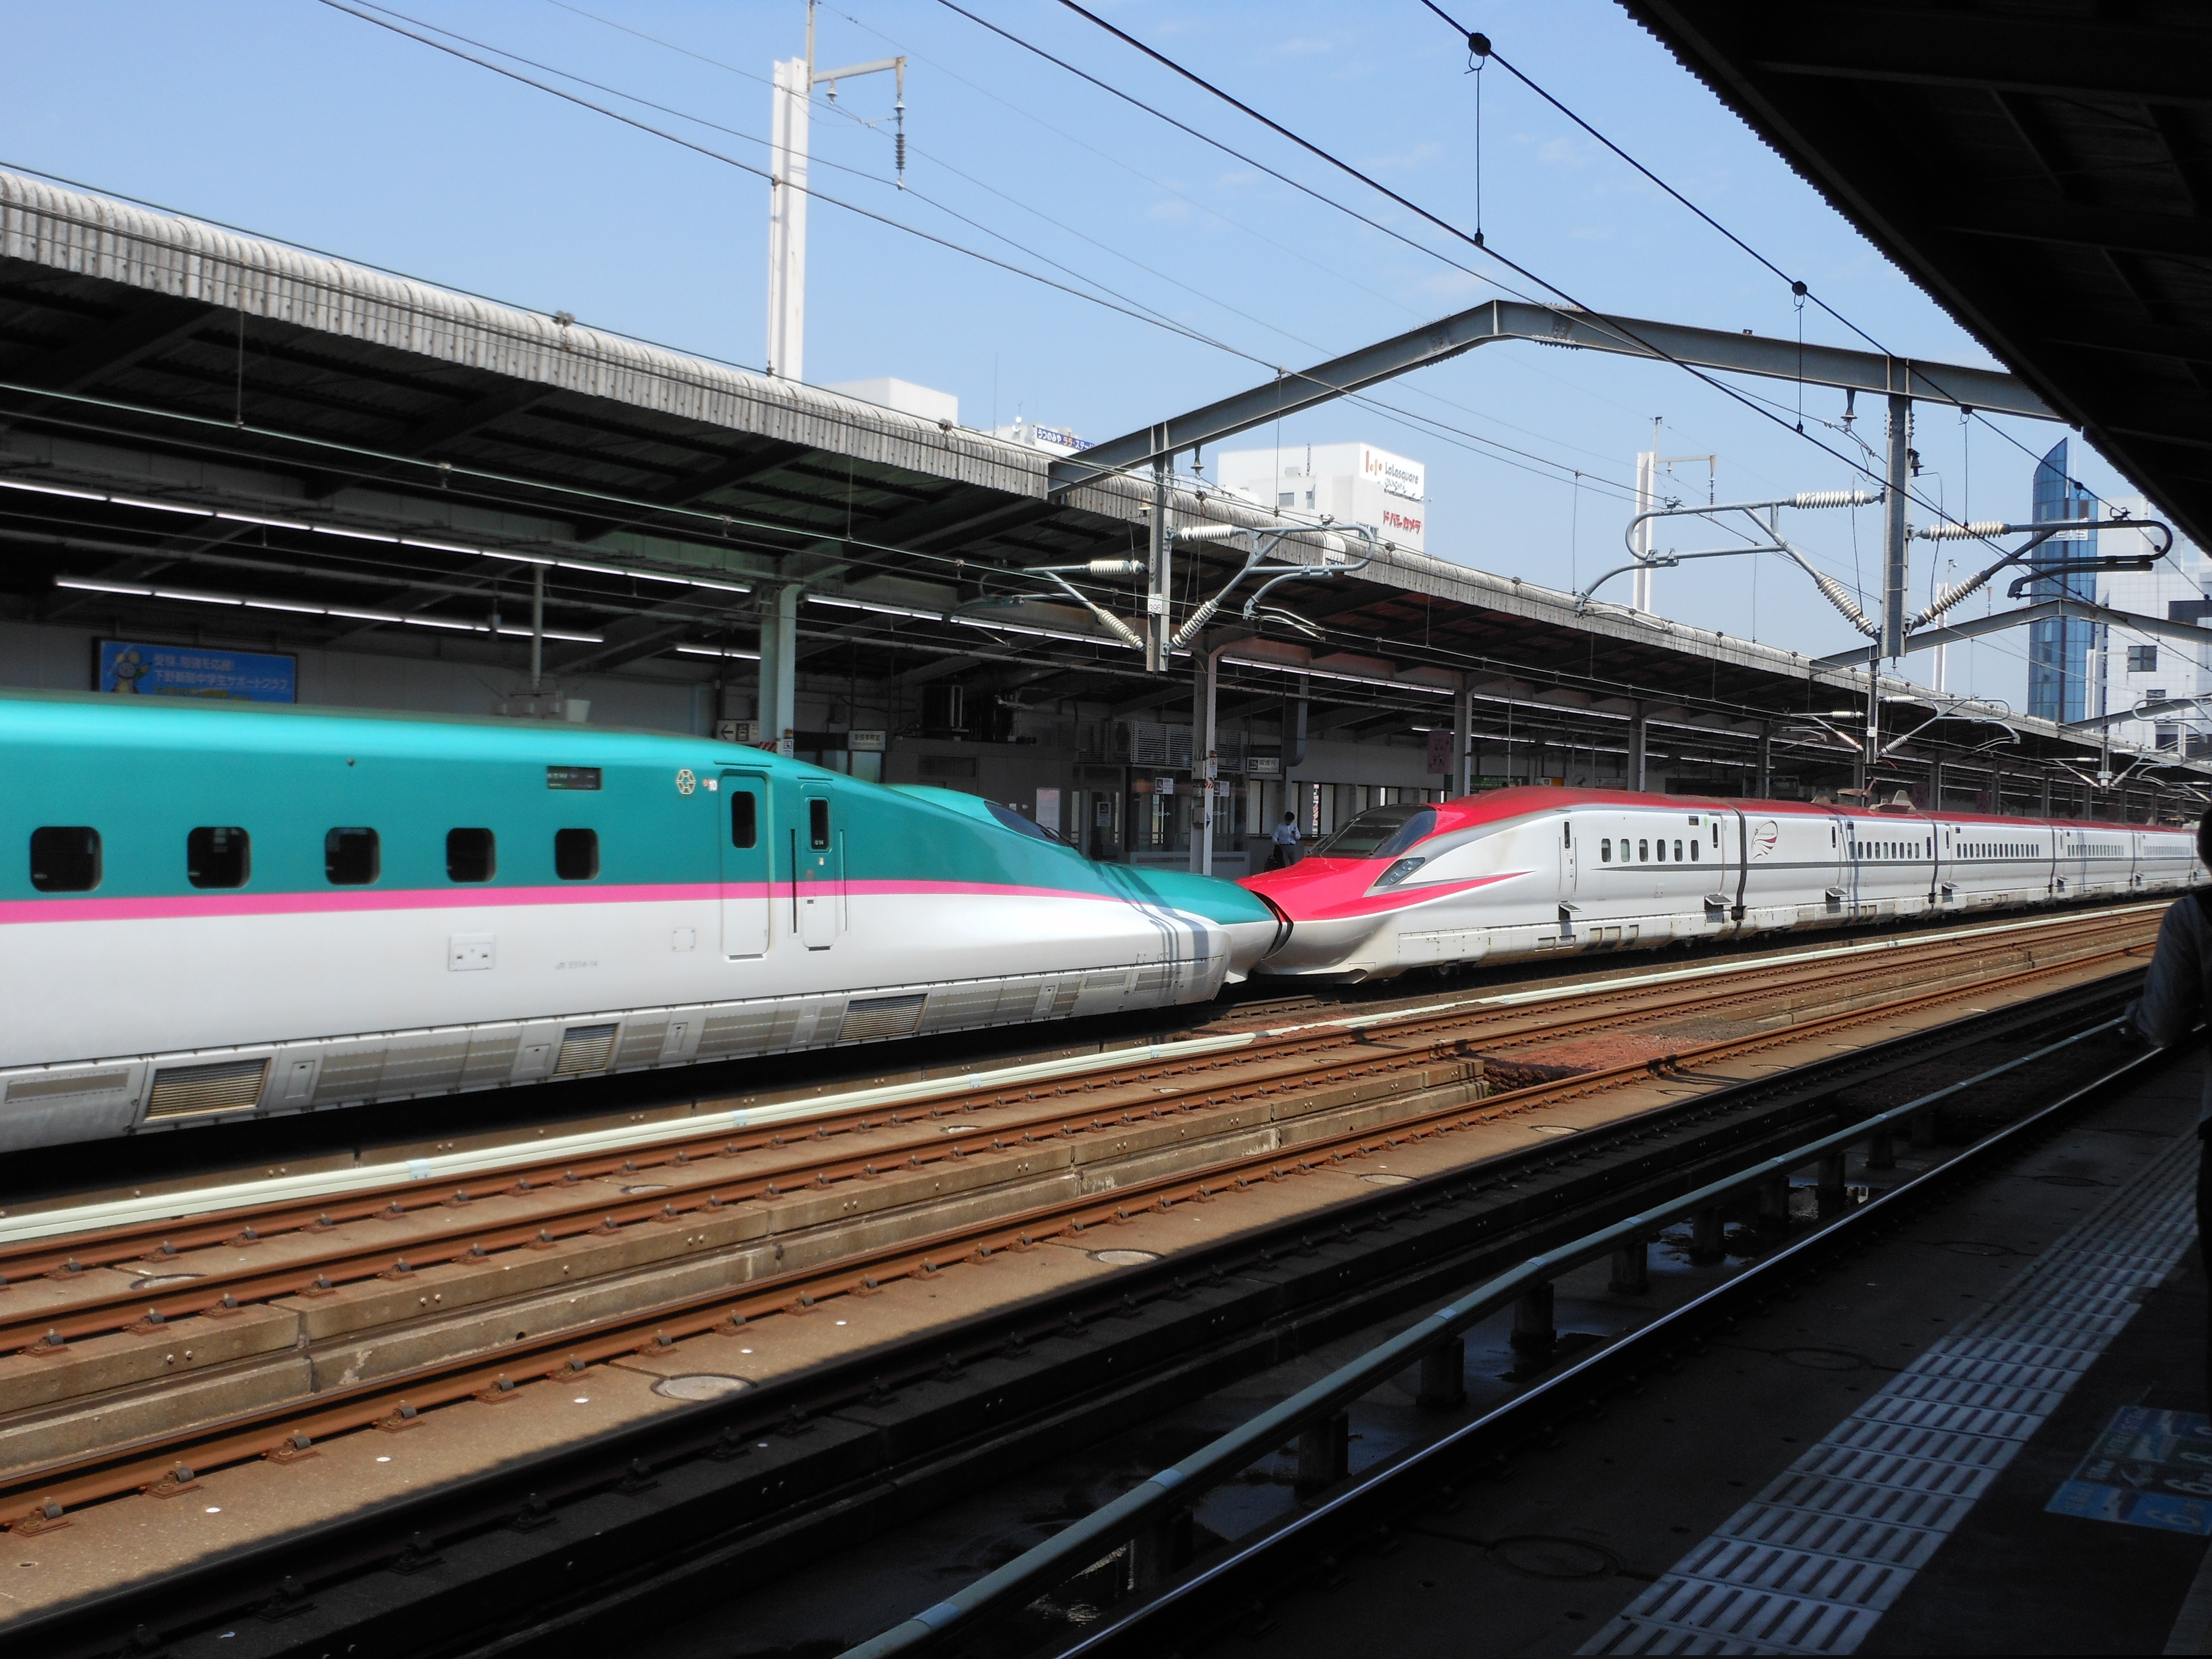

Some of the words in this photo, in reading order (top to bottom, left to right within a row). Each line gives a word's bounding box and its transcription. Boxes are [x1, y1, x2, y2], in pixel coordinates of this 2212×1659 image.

[1038, 429, 1062, 444] うつのみや
[1149, 604, 1161, 613] 396
[709, 781, 718, 791] 10
